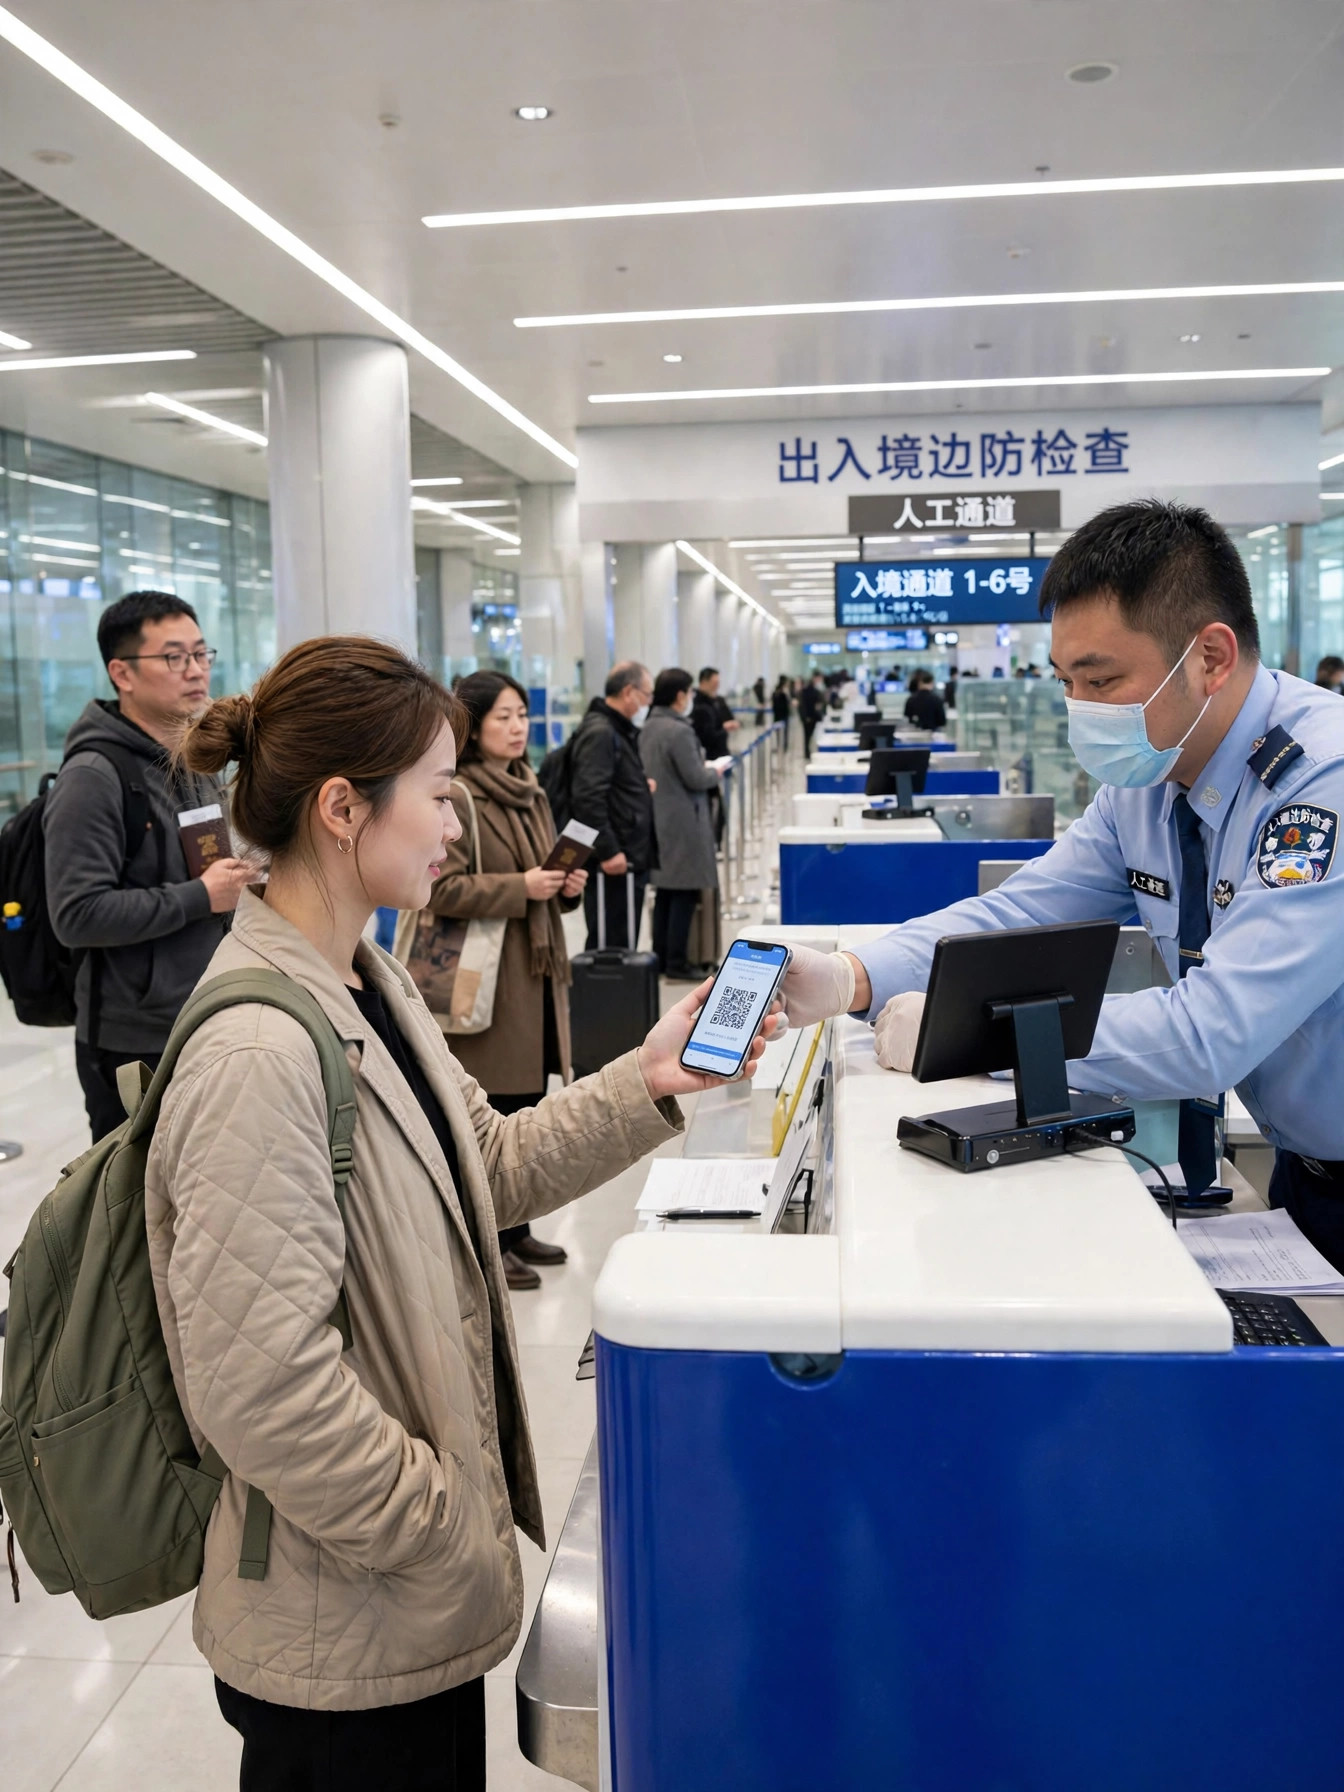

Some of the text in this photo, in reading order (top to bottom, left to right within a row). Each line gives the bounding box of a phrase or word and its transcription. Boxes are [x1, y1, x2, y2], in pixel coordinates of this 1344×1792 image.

[779, 427, 1130, 484] 出入境边防检查
[894, 496, 1016, 529] 人工通道
[850, 567, 1033, 598] 入境通道 1-6号
